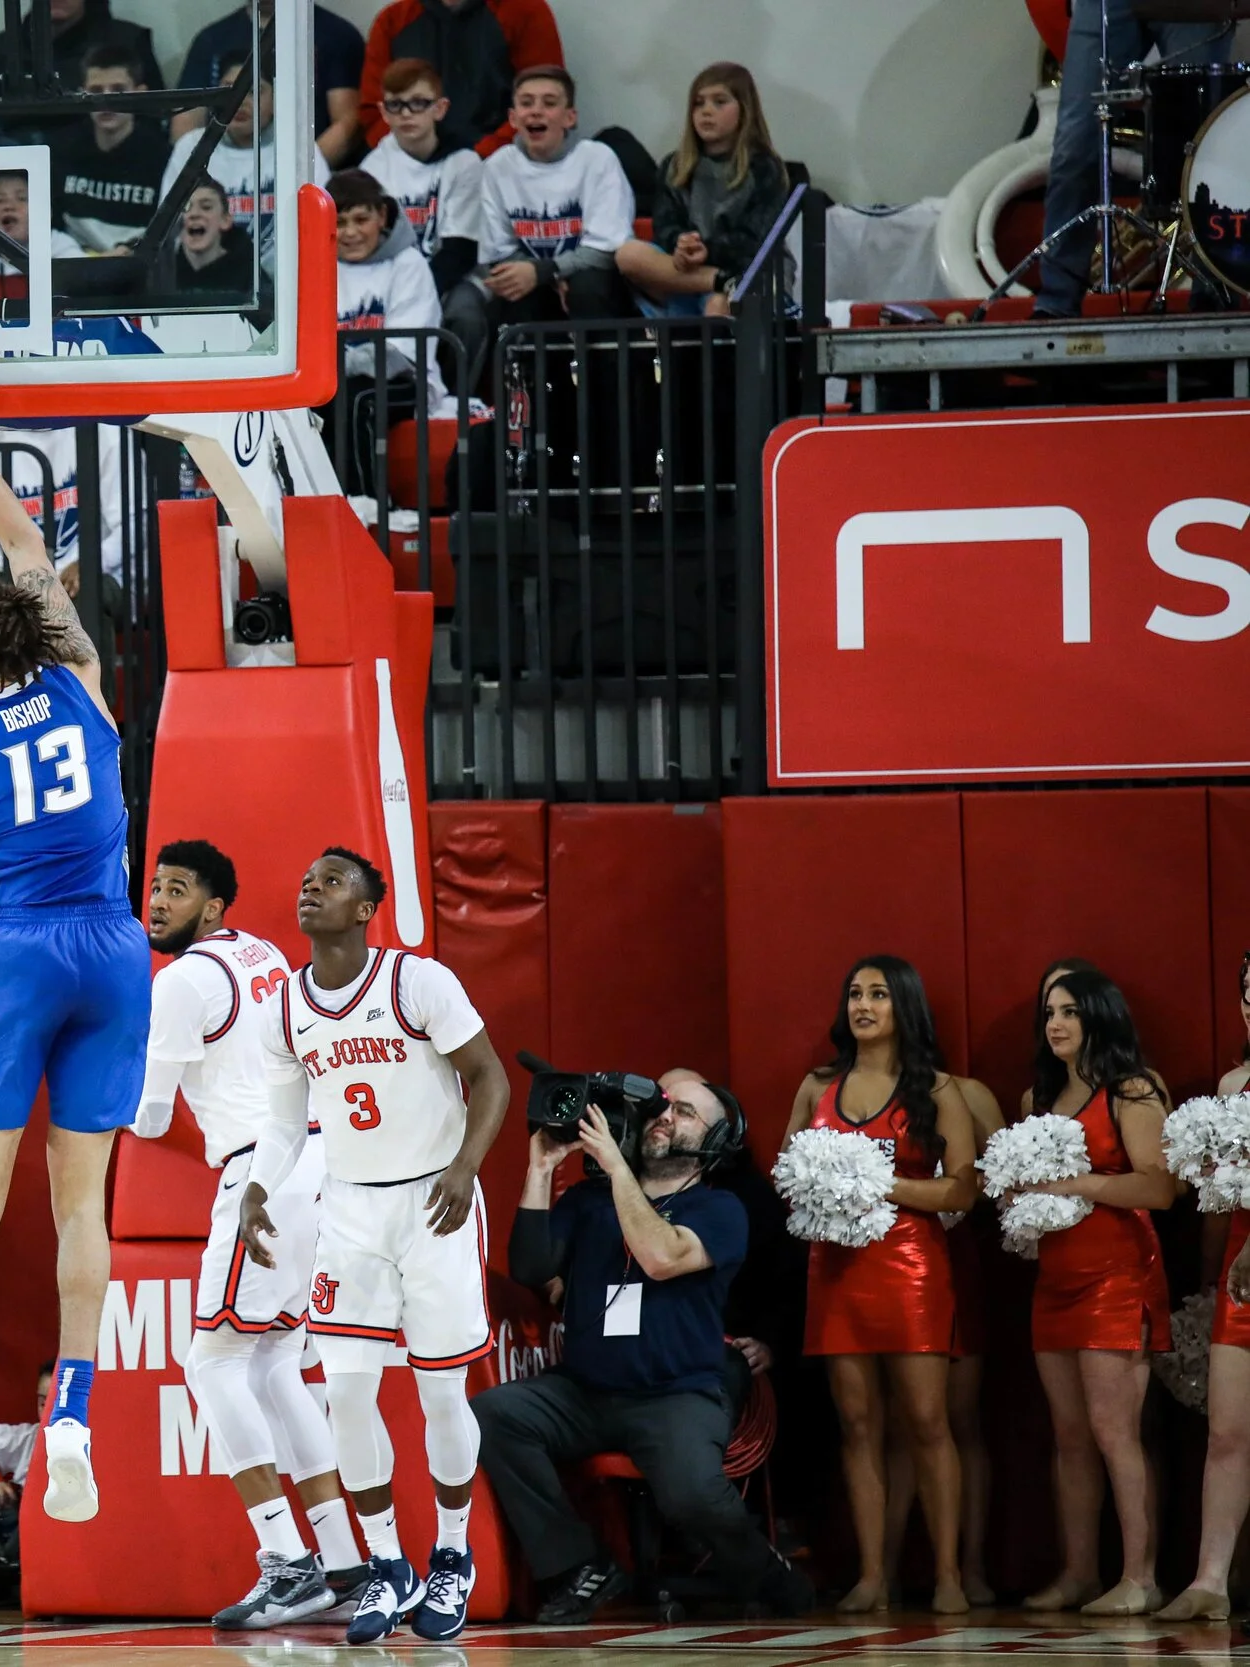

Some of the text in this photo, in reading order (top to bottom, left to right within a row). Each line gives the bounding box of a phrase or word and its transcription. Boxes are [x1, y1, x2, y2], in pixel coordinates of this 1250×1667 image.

[64, 175, 155, 205] HOLLISTER
[0, 693, 51, 733] BISHOP
[0, 724, 93, 827] 13
[327, 1037, 408, 1069] JOHN'S
[344, 1082, 382, 1131] 3
